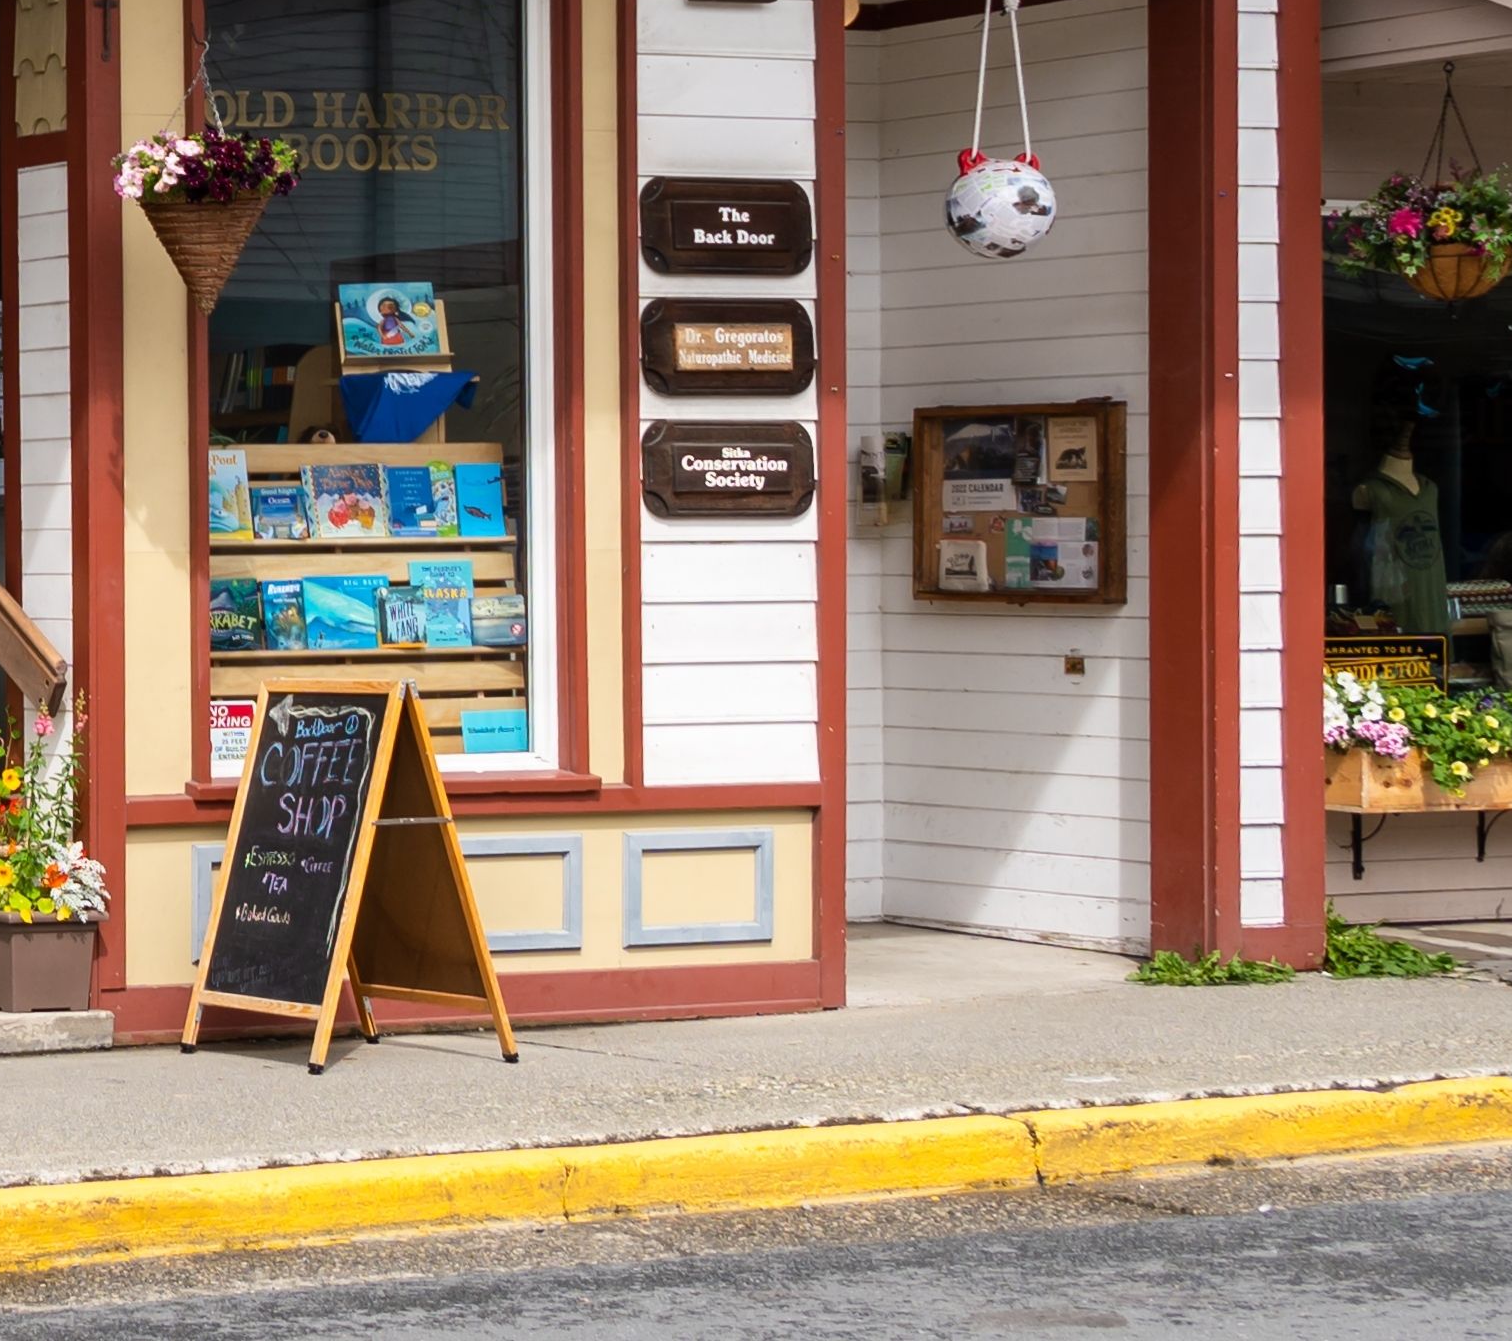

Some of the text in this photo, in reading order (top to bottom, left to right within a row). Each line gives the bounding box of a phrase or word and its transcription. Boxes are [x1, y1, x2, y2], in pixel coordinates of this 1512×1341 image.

[204, 90, 510, 131] OLD HARBOR
[280, 133, 439, 172] BOOKS
[718, 207, 751, 223] The
[693, 229, 775, 245] Back Door
[684, 327, 784, 348] Dr. Gregoratos
[678, 349, 792, 367] Naturopathic Medicine
[722, 447, 751, 459] Sitka
[681, 456, 788, 472] Conservation
[705, 473, 765, 490] Society
[968, 483, 1004, 493] CALENDAR
[389, 602, 416, 620] WHITE
[396, 618, 420, 637] FANG
[1325, 646, 1381, 654] ARRANTED
[210, 716, 251, 728] OKING
[261, 738, 362, 787] COFFEE
[278, 792, 347, 839] SHOP
